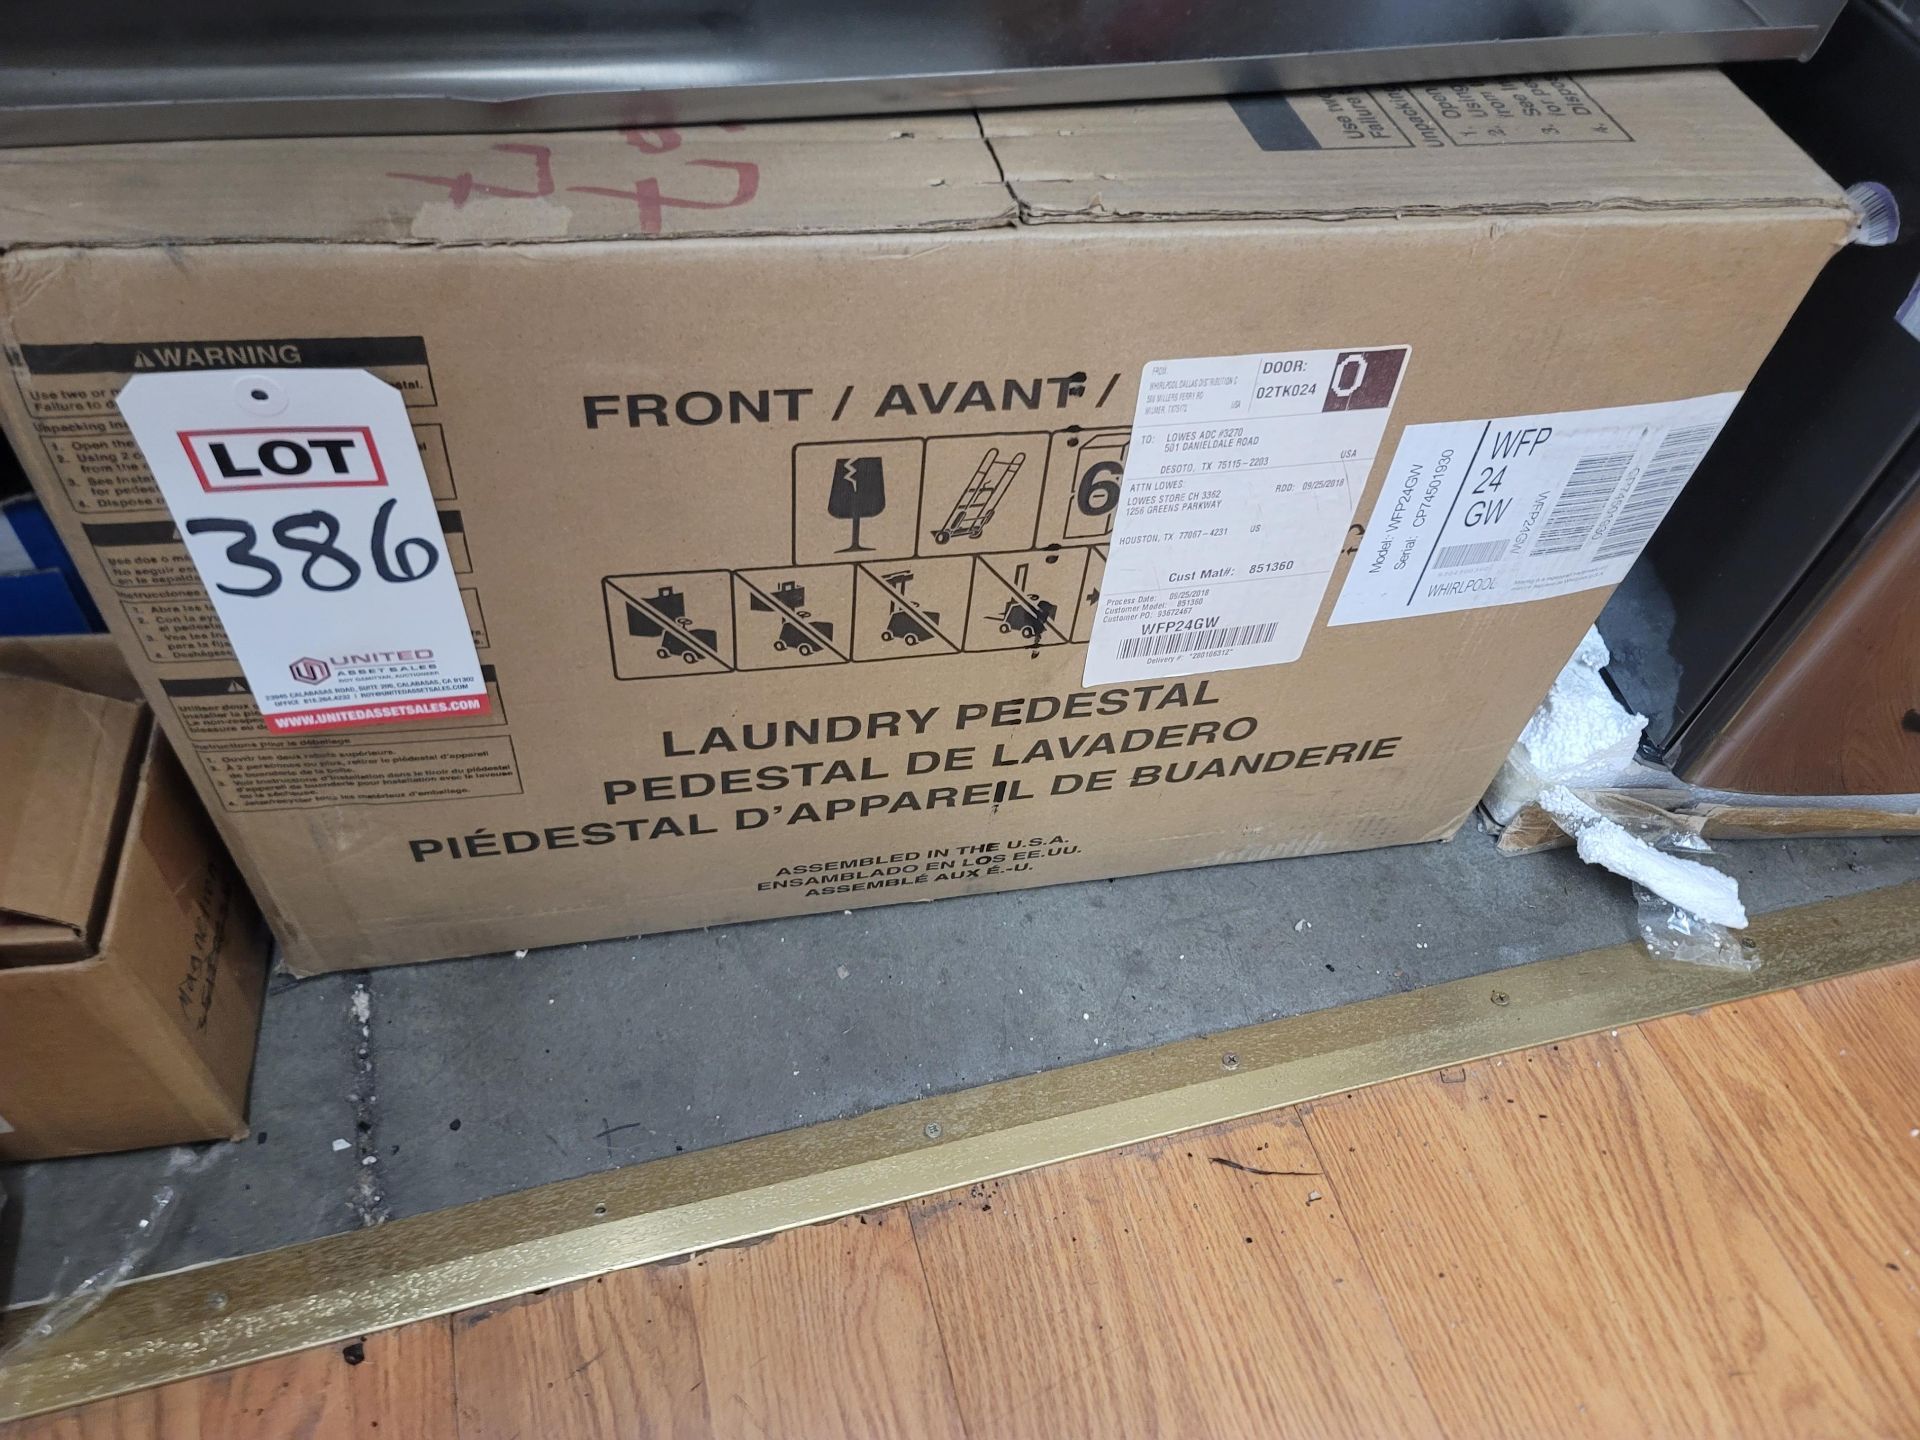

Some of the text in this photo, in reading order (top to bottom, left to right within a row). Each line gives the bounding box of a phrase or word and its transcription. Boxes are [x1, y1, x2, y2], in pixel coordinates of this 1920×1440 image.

[1514, 93, 1542, 117] See
[1337, 115, 1365, 139] Use
[1347, 97, 1391, 138] Failure
[152, 344, 303, 367] WARNING
[1262, 360, 1309, 375] DOOR:
[30, 389, 105, 400] Use two or
[1256, 383, 1317, 400] 02TK024
[34, 400, 103, 412] Failure to
[582, 387, 813, 429] FRONT
[832, 385, 855, 421] /
[874, 376, 1083, 418] AVANT
[72, 441, 108, 452] Open
[111, 439, 135, 449] the
[1141, 427, 1245, 445] TO: LOWES ADC #3270
[1164, 436, 1260, 453] 501 DANIELDALE ROAD
[1491, 427, 1553, 460] WFP
[76, 453, 118, 464] Using
[208, 439, 356, 478] LOT
[1340, 449, 1357, 459] USA
[1160, 463, 1196, 475] DESOTO,
[1201, 461, 1213, 471] TX
[87, 476, 114, 486] See
[1078, 461, 1124, 516] 6
[1130, 479, 1184, 493] ATTN LOWES
[1472, 465, 1508, 495] 24
[1127, 489, 1221, 506] LOWES STORE CH 3362
[1126, 500, 1223, 517] 1256 GREENS PARKWAY
[1369, 463, 1424, 574] Model: WFP24GW
[1394, 449, 1455, 571] Serial: CP74501930
[1464, 496, 1514, 528] GW
[1249, 524, 1262, 533] US
[185, 497, 440, 598] 386
[1119, 533, 1160, 546] HOUSTON,
[1164, 532, 1175, 541] TX
[1168, 560, 1295, 583] Cust Mat#: 851360
[1427, 577, 1498, 598] WHIRLPOOL
[1104, 605, 1140, 616] Customer
[1142, 602, 1168, 611] Model:
[1106, 596, 1136, 606] Process
[1138, 594, 1158, 604] Date:
[1102, 614, 1139, 624] Customer
[1140, 611, 1153, 620] PO:
[1141, 616, 1221, 636] WFP24GW
[330, 649, 434, 667] UNITED
[1146, 655, 1175, 665] Delivery
[337, 668, 385, 678] ASSET
[389, 663, 438, 674] SALES
[275, 699, 480, 728] WWW.UNITEDASSETSALES.COM
[662, 680, 1220, 758] LAUNDRY PEDESTAL
[603, 717, 1259, 806] PEDESTAL DE LAVADERO
[408, 815, 718, 863] PIÉDESTAL
[1051, 770, 1117, 796] DE
[1129, 736, 1403, 788] BUANDERIE
[775, 835, 1070, 877] ASSEMBLED IN THE U.S.A.
[757, 845, 1083, 893] ENSAMBLADO EN LOS EE.UU.
[804, 861, 1034, 898] ASSEMBLÉ AUX É.-U.
